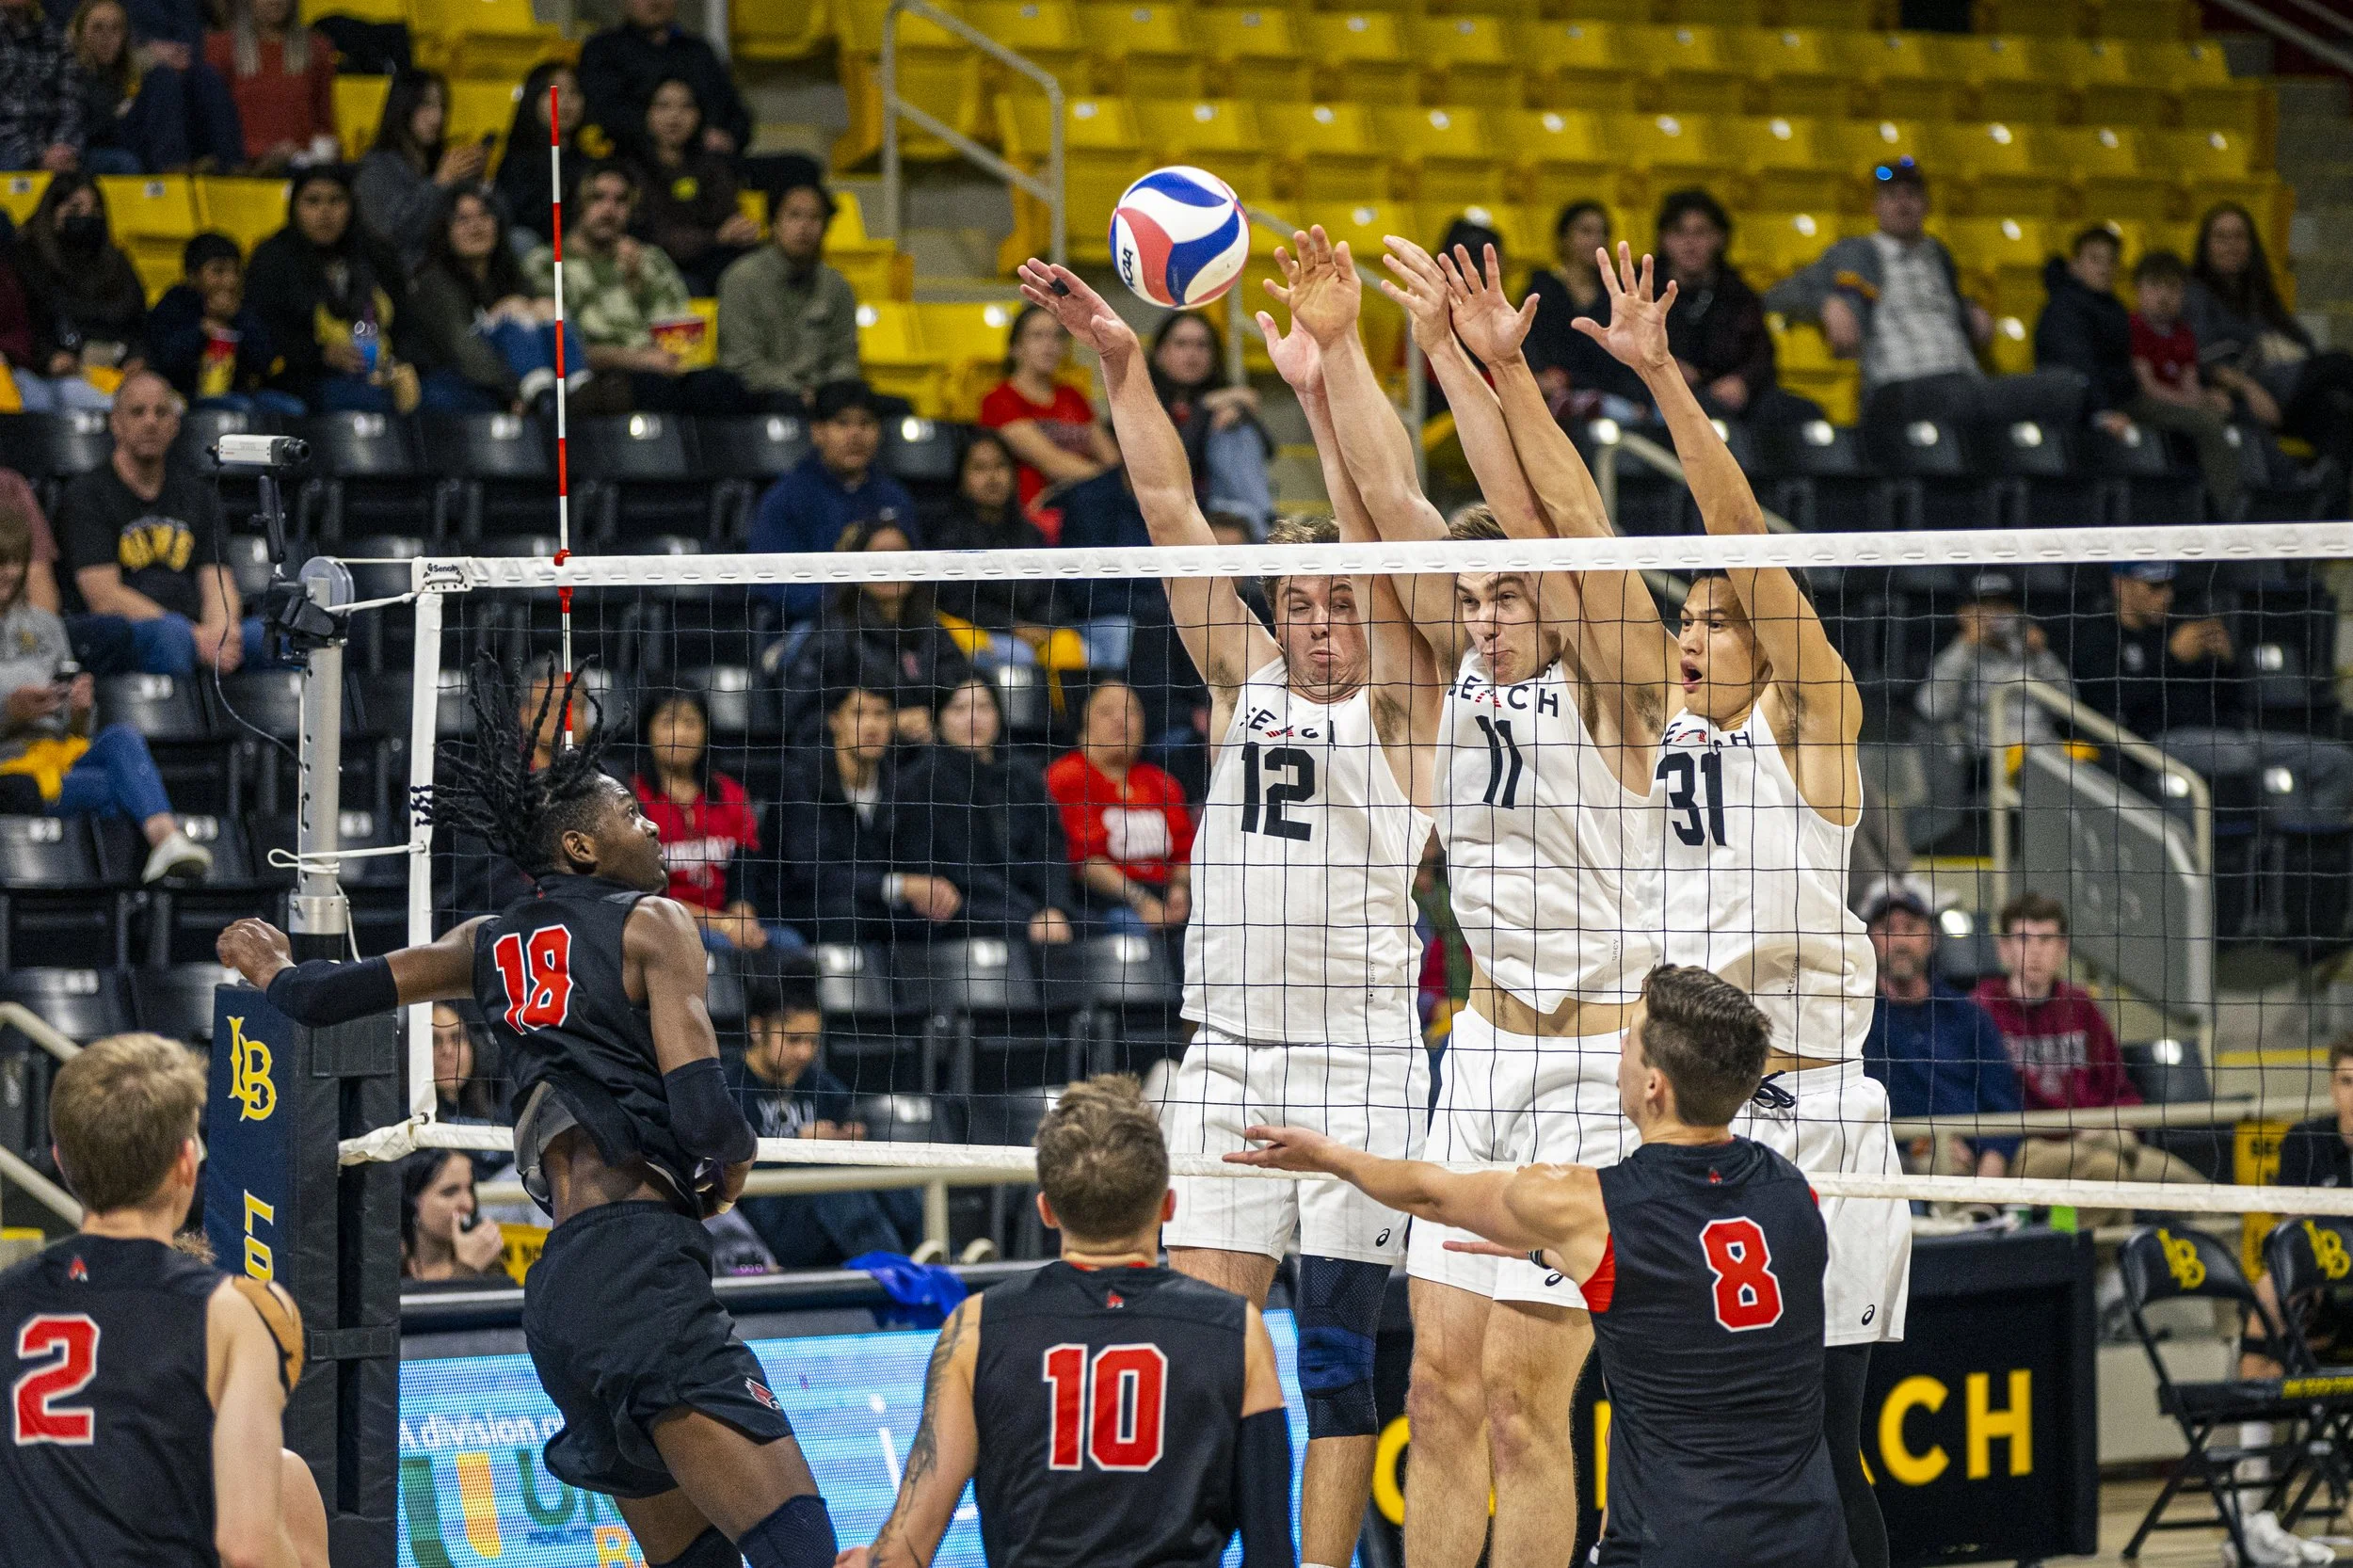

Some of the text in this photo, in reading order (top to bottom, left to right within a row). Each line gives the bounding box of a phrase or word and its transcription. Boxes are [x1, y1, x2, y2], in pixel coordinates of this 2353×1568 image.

[1241, 741, 1316, 841] 12
[1475, 714, 1524, 809] 11
[1657, 751, 1727, 846] 31
[493, 923, 574, 1035] 18
[227, 1016, 278, 1122] LB
[1699, 1215, 1785, 1333] 8
[13, 1314, 101, 1446] 2
[421, 1411, 538, 1450] division
[1042, 1343, 1169, 1473] 10
